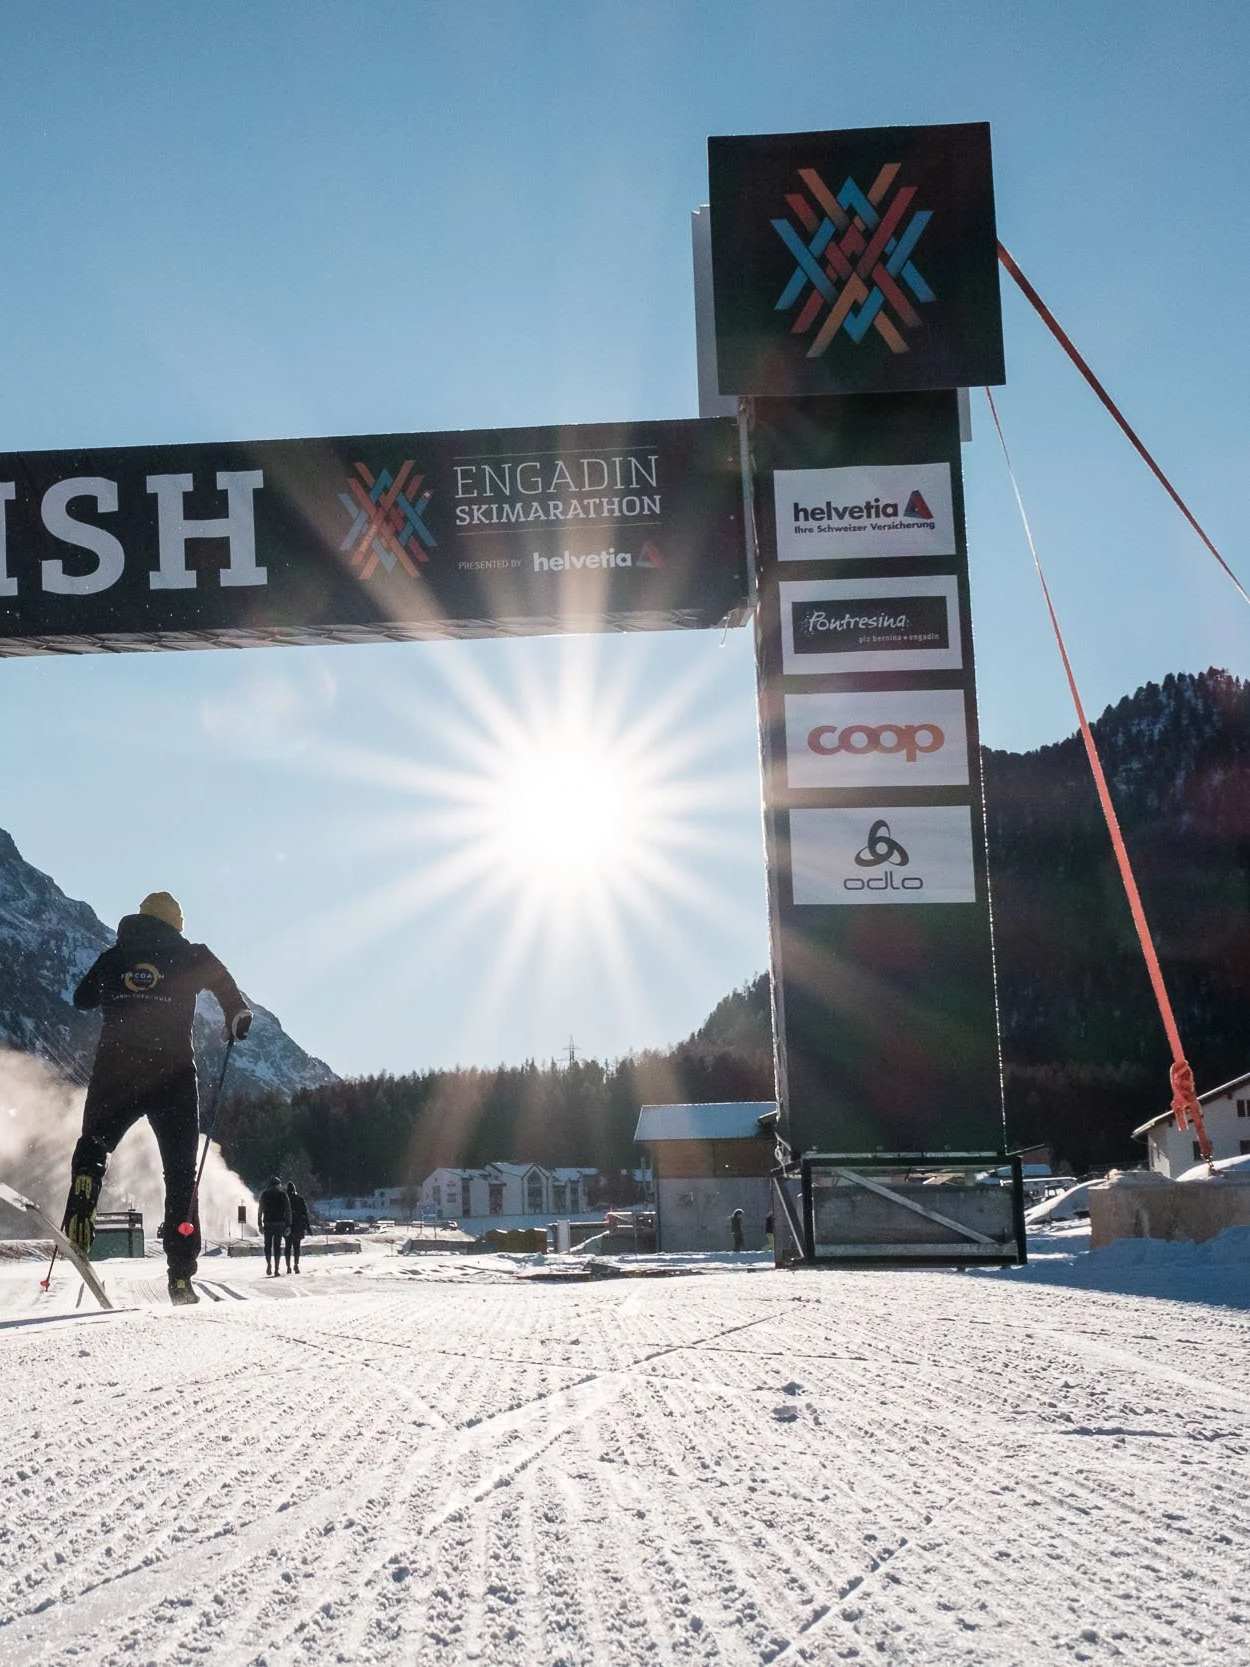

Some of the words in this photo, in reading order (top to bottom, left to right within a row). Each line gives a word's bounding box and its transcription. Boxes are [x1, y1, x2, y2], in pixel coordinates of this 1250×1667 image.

[454, 456, 659, 498] ENGADIN
[456, 495, 661, 526] SKIMARATHON
[793, 498, 898, 522] helvetia
[795, 526, 814, 534] Ihre
[817, 524, 867, 533] Schweizer
[870, 521, 935, 531] Versicherung
[458, 560, 509, 570] PRESENTED
[511, 559, 521, 568] BY
[533, 548, 632, 572] helvetia
[809, 611, 907, 631] Pontresina
[909, 632, 940, 643] engadin
[807, 724, 945, 762] coop
[844, 871, 923, 890] odlo
